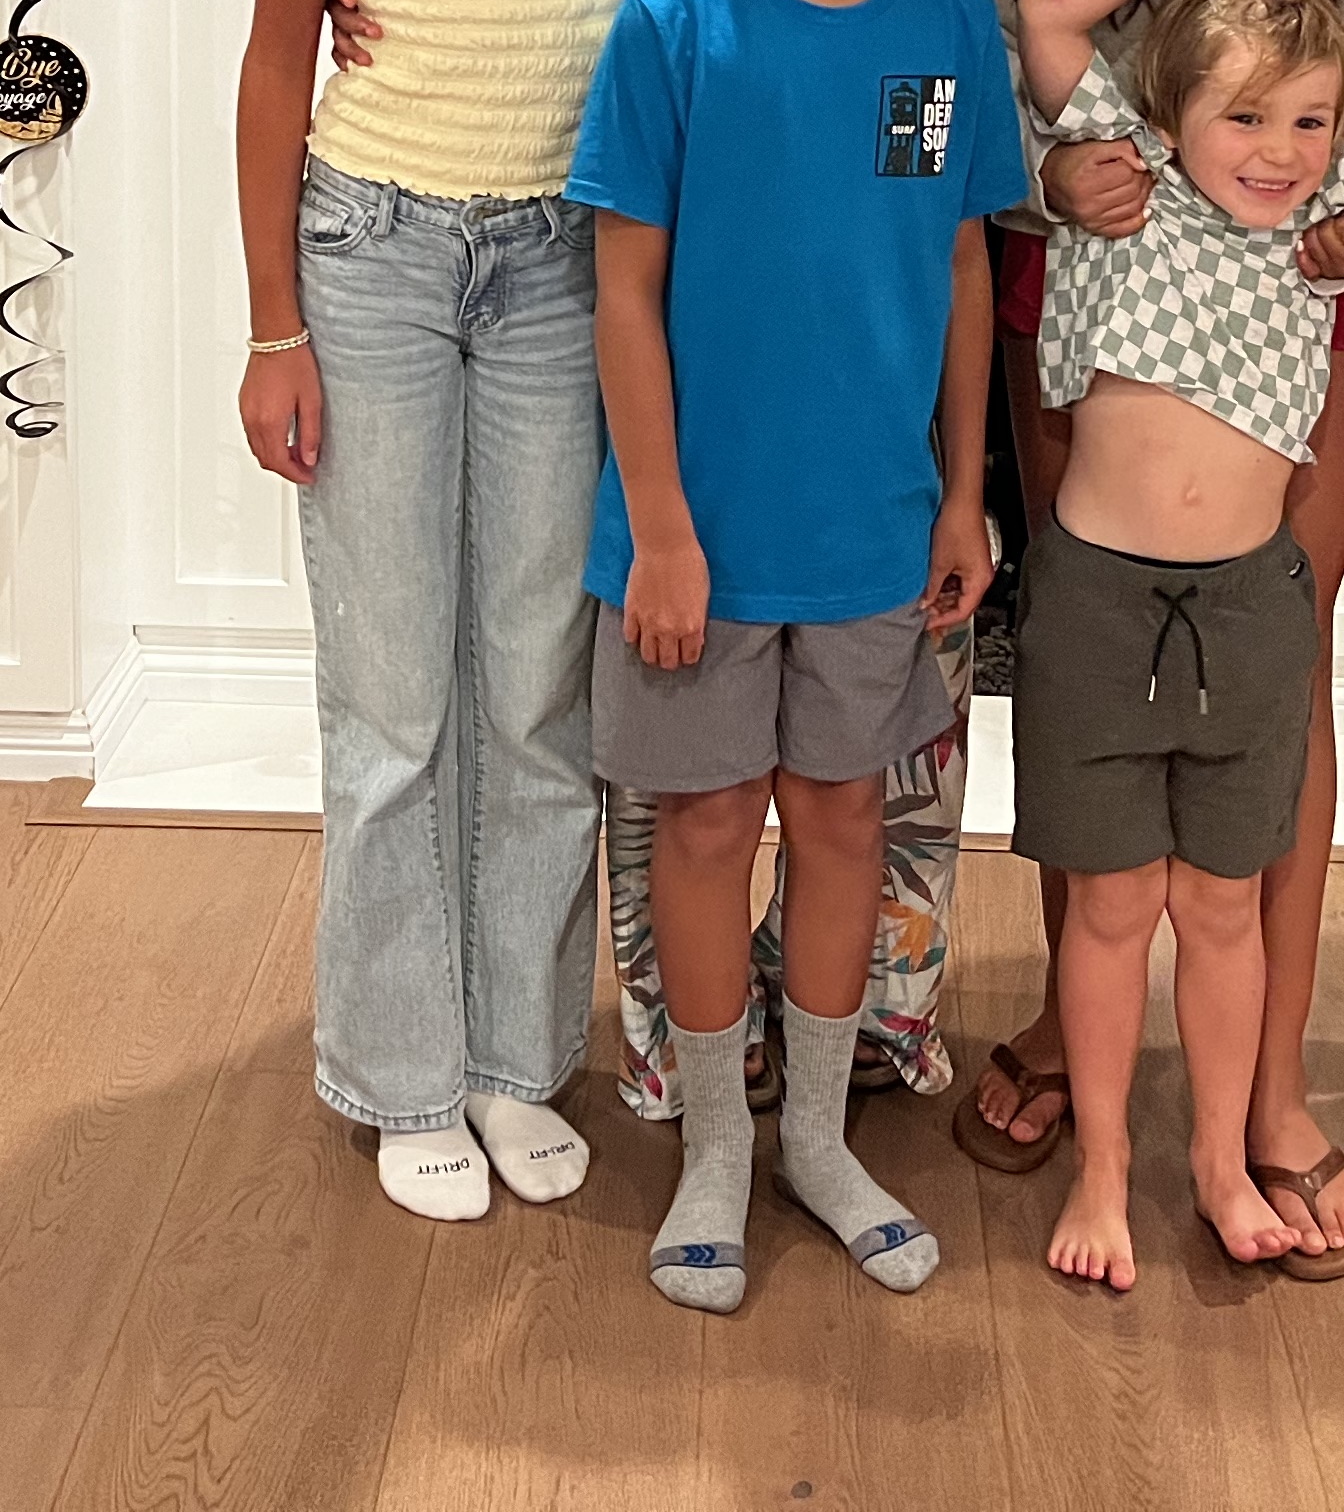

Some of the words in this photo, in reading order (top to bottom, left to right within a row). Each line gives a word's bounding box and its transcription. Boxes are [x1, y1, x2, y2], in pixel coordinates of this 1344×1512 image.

[0, 47, 62, 89] Bye
[933, 78, 956, 103] AN
[923, 102, 953, 127] DER
[529, 1140, 576, 1161] DRI-FIT
[416, 1157, 471, 1176] DRI-FIT
